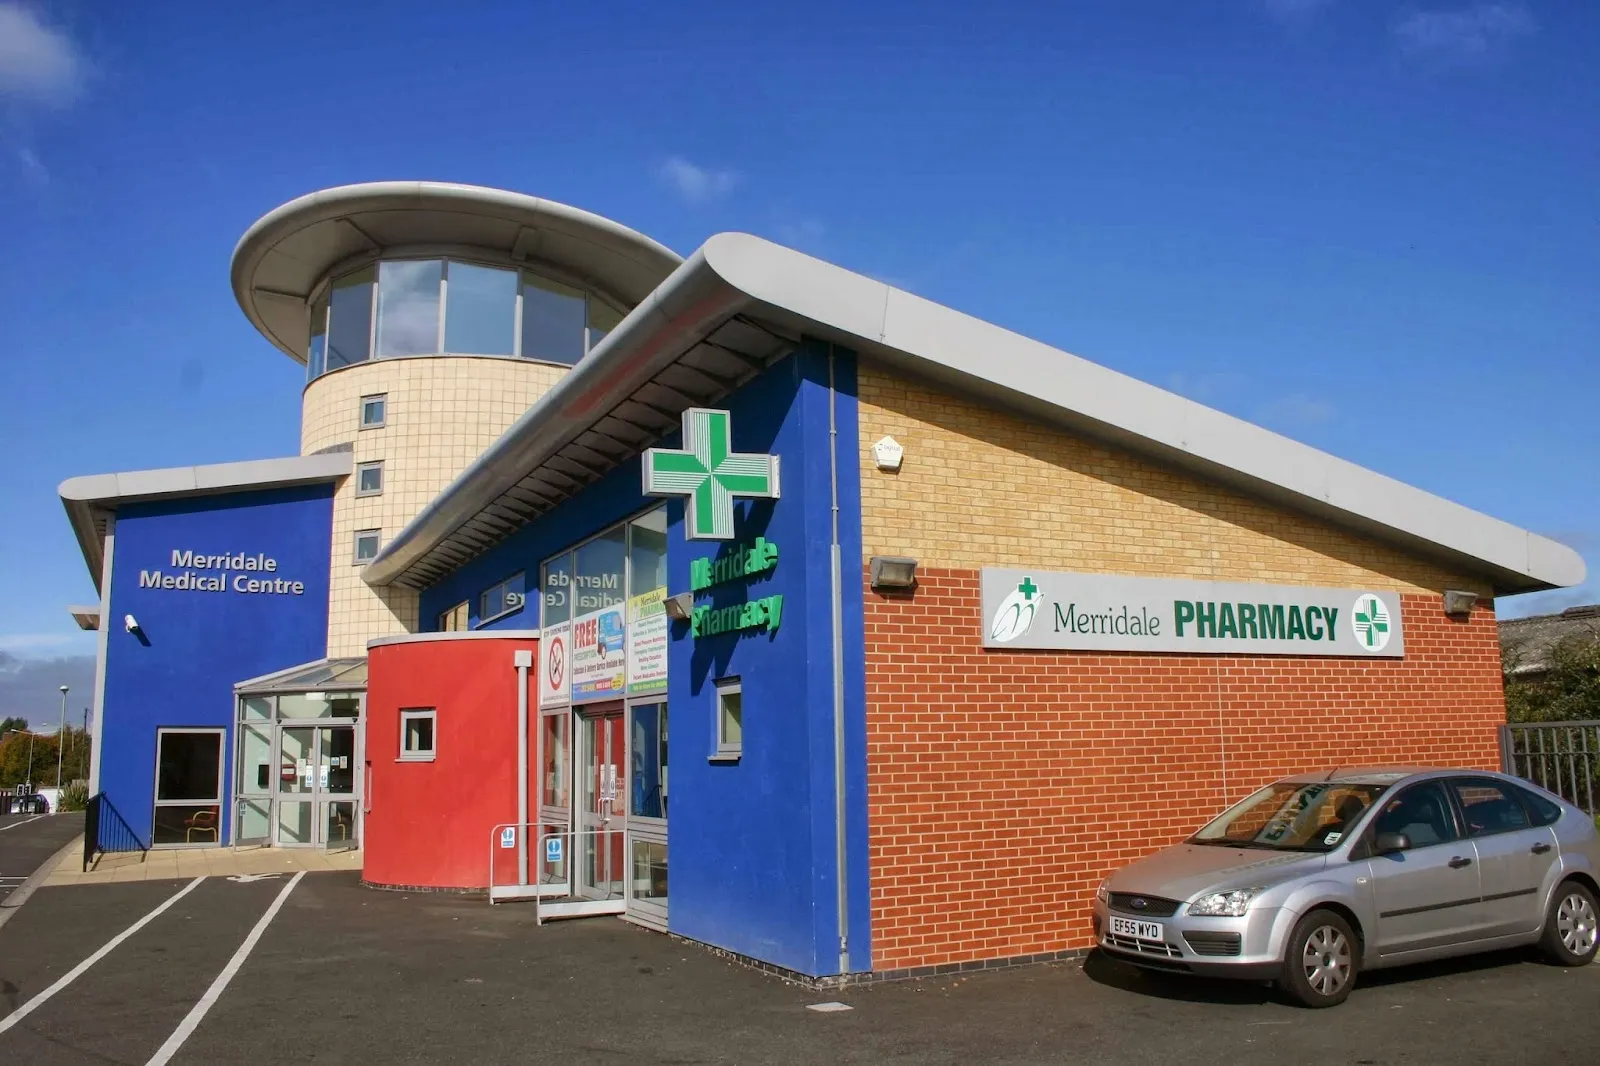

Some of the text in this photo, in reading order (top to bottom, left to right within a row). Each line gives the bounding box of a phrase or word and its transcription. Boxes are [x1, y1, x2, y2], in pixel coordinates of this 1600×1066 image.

[171, 549, 277, 572] Merridale
[691, 536, 778, 591] Merridale
[139, 570, 304, 595] Medical Centre
[692, 594, 783, 639] Pharmacy
[1053, 600, 1339, 642] Merridale PHARMACY
[574, 618, 597, 650] FREE
[1114, 918, 1158, 938] EF55 WYD
